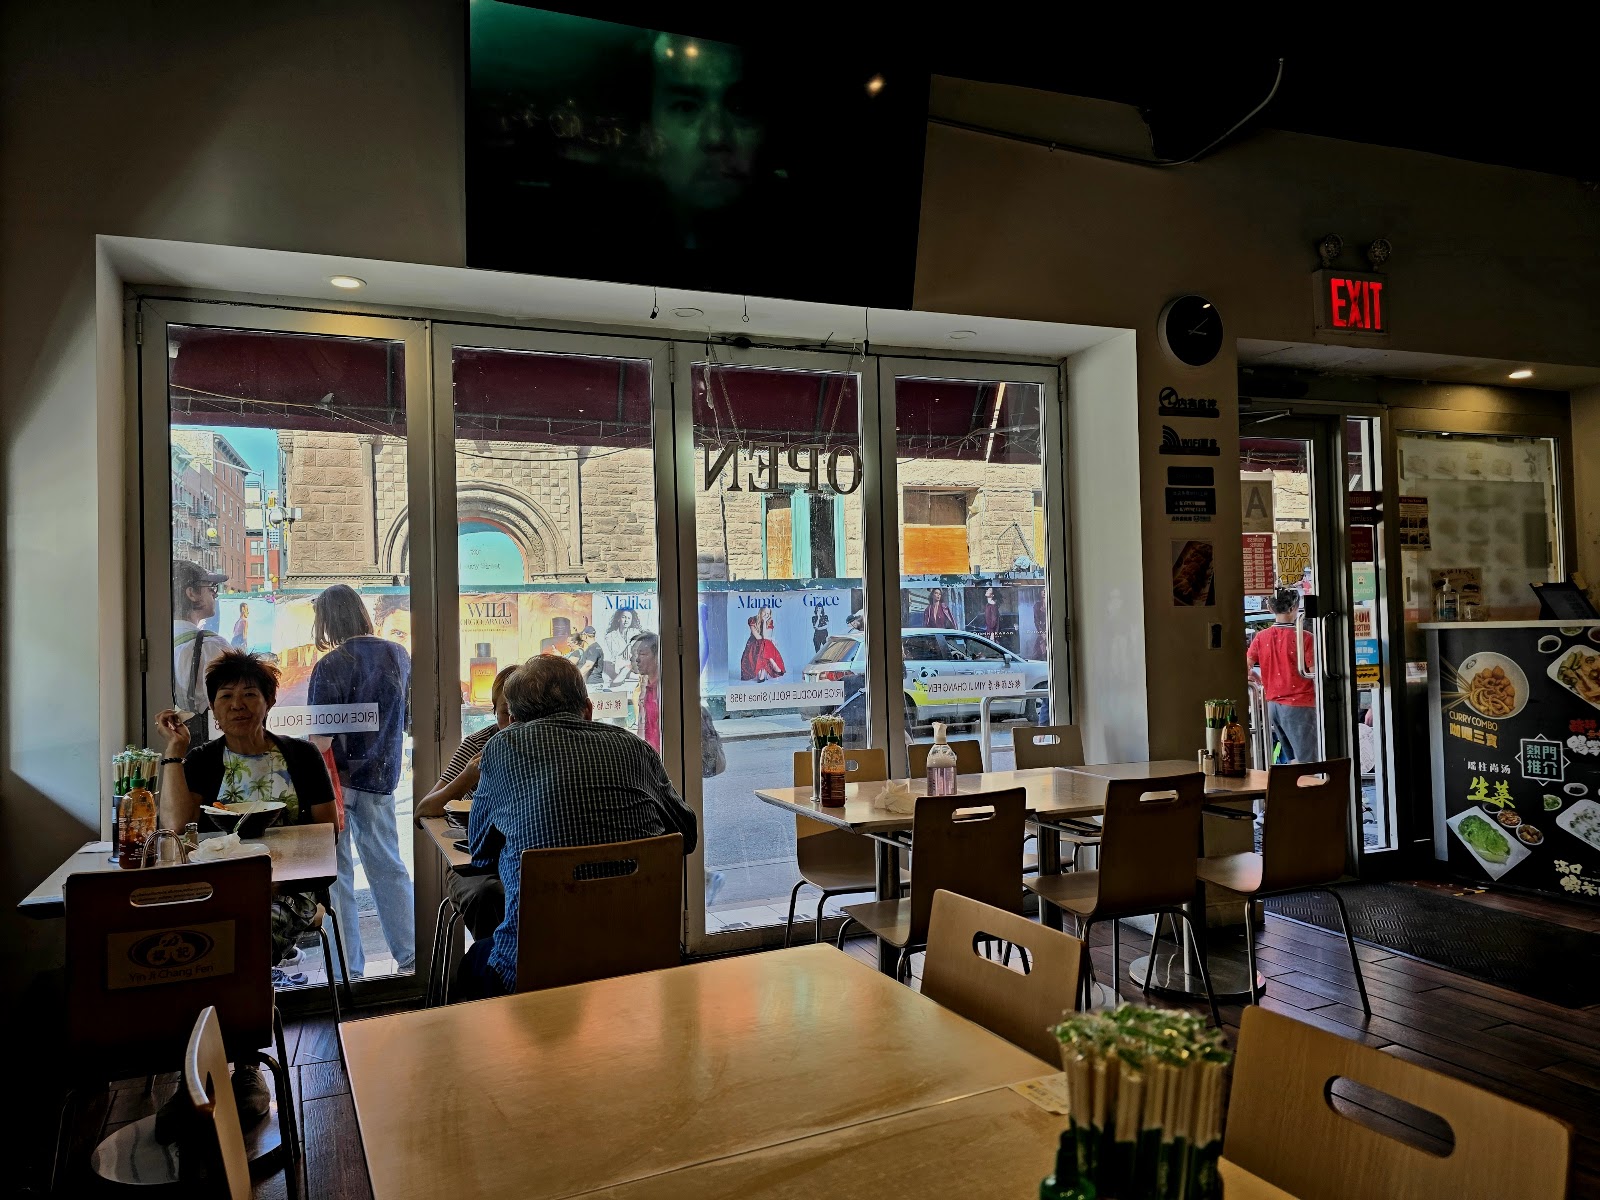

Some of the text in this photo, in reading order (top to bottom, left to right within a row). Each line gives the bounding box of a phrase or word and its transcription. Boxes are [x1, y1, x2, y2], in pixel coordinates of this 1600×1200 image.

[1331, 278, 1383, 330] EXIT
[1245, 486, 1268, 518] A
[605, 595, 652, 610] Malika
[737, 594, 783, 609] Mamie
[802, 593, 840, 607] Grace
[465, 602, 512, 618] WILL
[1449, 710, 1498, 731] CURRY COMBO
[1526, 744, 1557, 760] 熱門
[1527, 760, 1558, 776] 推介
[1467, 775, 1516, 808] 生菜
[158, 968, 192, 979] Chang
[195, 965, 214, 974] Fen
